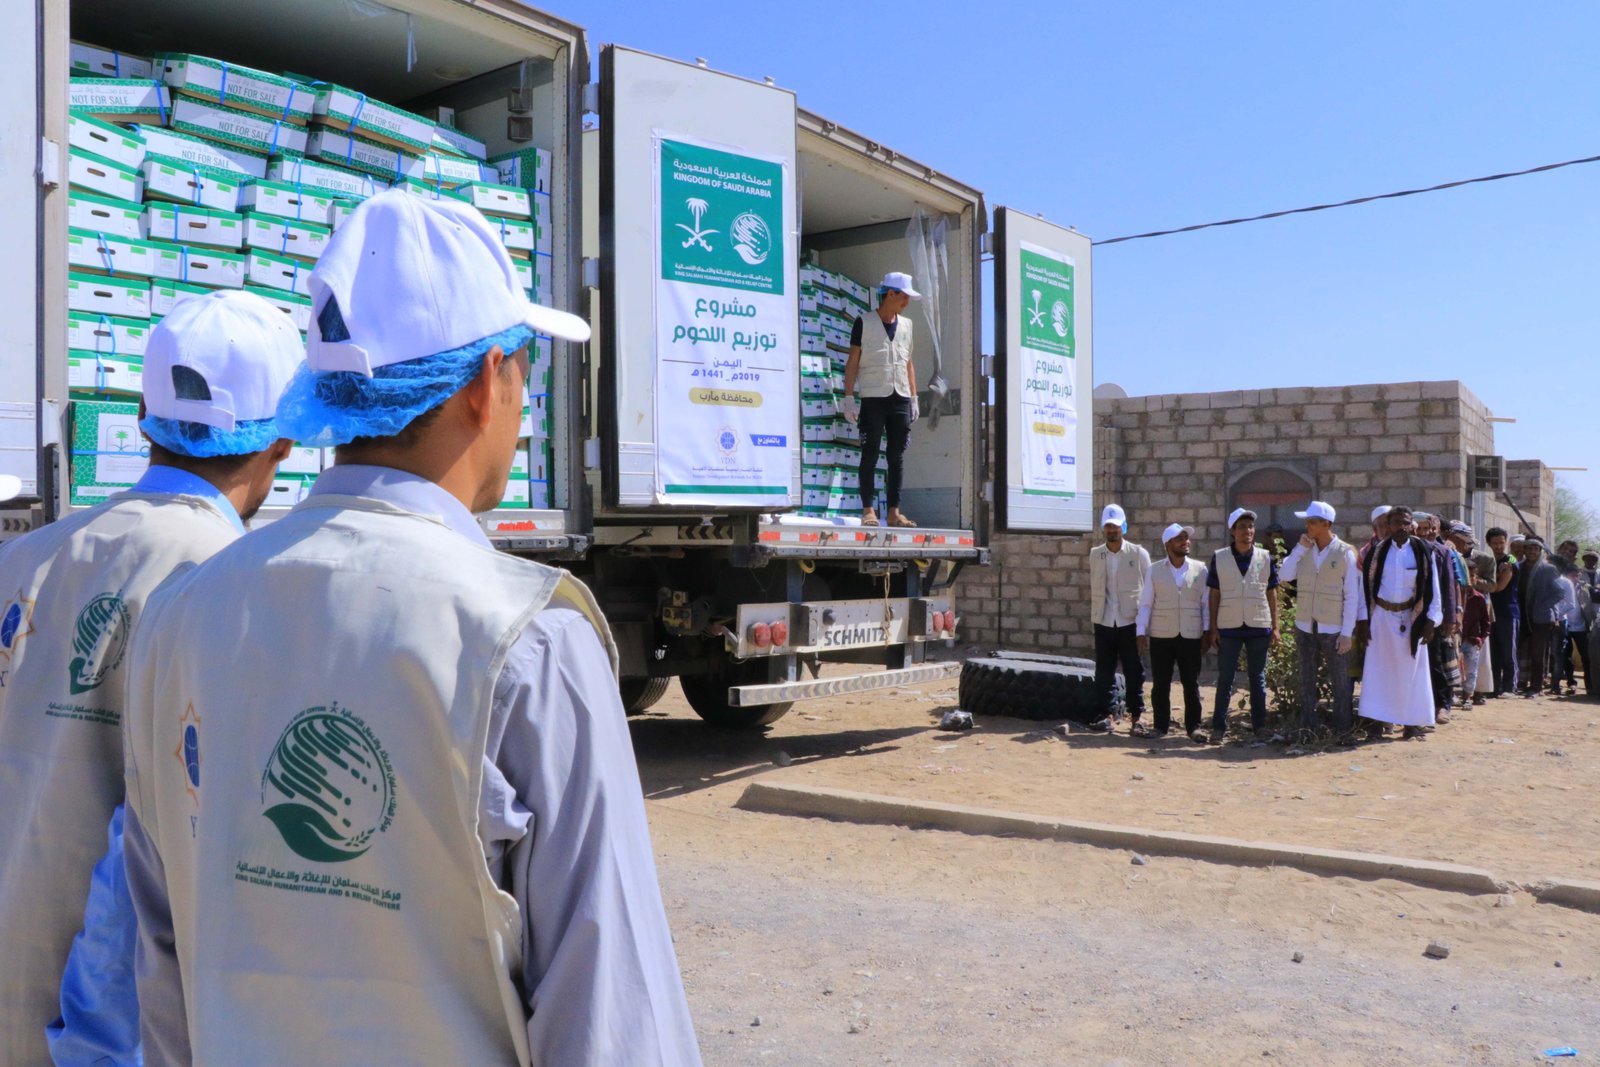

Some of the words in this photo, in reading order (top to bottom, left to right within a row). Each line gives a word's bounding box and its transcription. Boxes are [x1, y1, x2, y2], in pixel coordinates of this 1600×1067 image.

[72, 95, 89, 104] NOT
[90, 96, 108, 105] FOR
[109, 97, 128, 105] SALE
[227, 84, 242, 94] NOT
[243, 87, 258, 98] FOR
[259, 92, 278, 104] SALE
[361, 112, 374, 121] NOT
[374, 115, 388, 127] FOR
[388, 120, 401, 132] SALE
[218, 122, 233, 131] NOT
[235, 125, 249, 137] FOR
[251, 129, 270, 142] SALE
[181, 149, 196, 160] NOT
[198, 153, 211, 164] FOR
[213, 158, 230, 169] SALE
[355, 151, 367, 160] NOT
[368, 153, 380, 164] FOR
[380, 157, 394, 169] SALE
[673, 158, 713, 174] السعودية
[713, 166, 741, 180] العربية
[741, 173, 772, 186] المملكة
[316, 177, 329, 187] NOT
[331, 179, 343, 189] FOR
[344, 182, 358, 193] SALE
[673, 171, 710, 186] KINGDOM
[711, 179, 722, 188] OF
[723, 181, 745, 193] SAUDI
[745, 186, 772, 198] ARABIA
[695, 297, 757, 319] مشروع
[672, 325, 725, 345] اللحوم
[732, 331, 777, 352] توزيع
[713, 357, 742, 369] اليمن
[1035, 360, 1063, 374] مشروع
[702, 369, 724, 379] 1441
[1026, 378, 1050, 392] اللحوم
[1052, 383, 1072, 398] توزيع
[699, 391, 720, 402] مأرب
[721, 392, 753, 404] محافظة
[824, 627, 888, 646] SCHMITZ
[274, 881, 326, 894] HUMANITARIAN
[332, 876, 360, 889] سلمان
[381, 889, 401, 901] مركز
